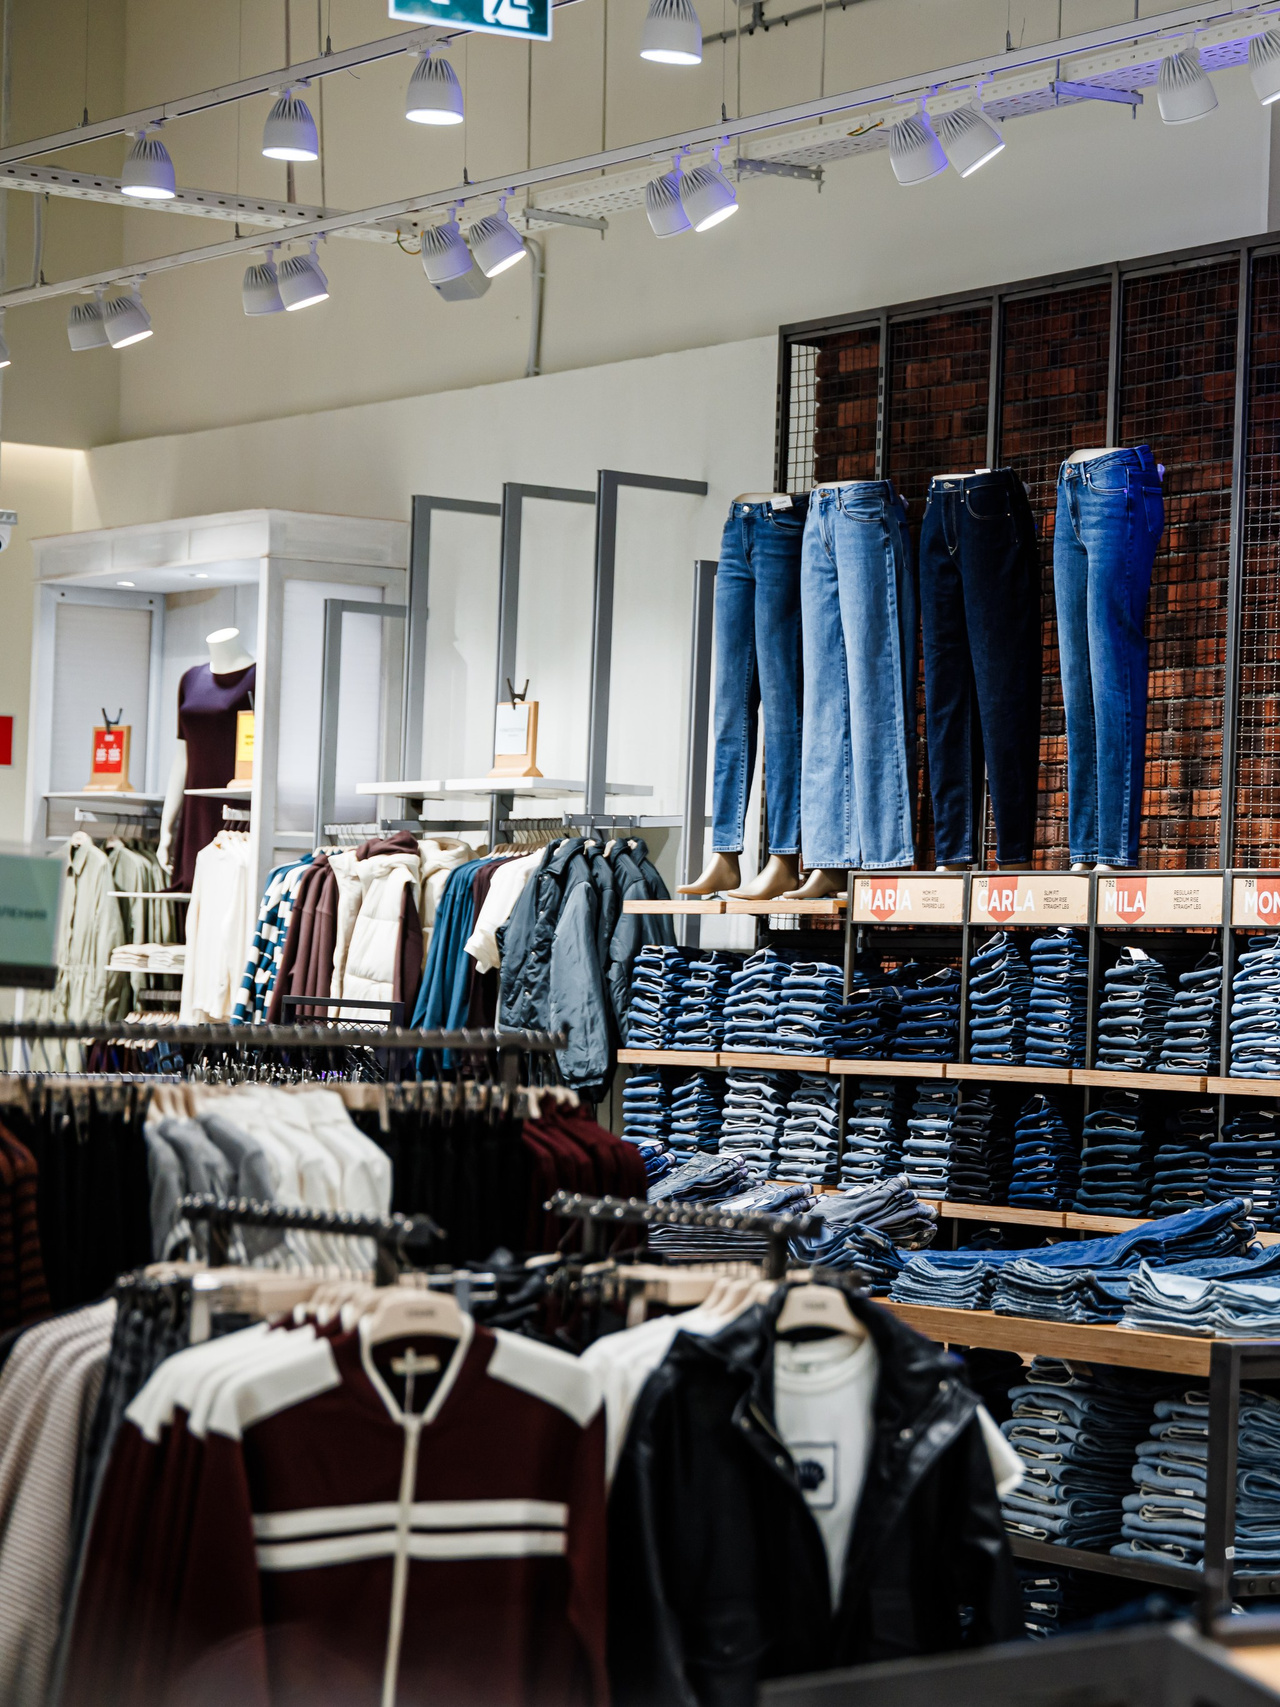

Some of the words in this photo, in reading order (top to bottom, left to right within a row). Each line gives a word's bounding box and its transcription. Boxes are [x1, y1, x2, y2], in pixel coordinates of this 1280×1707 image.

[860, 889, 912, 911] MARIA
[977, 889, 1035, 911] CARLA
[1104, 890, 1145, 912] MILA
